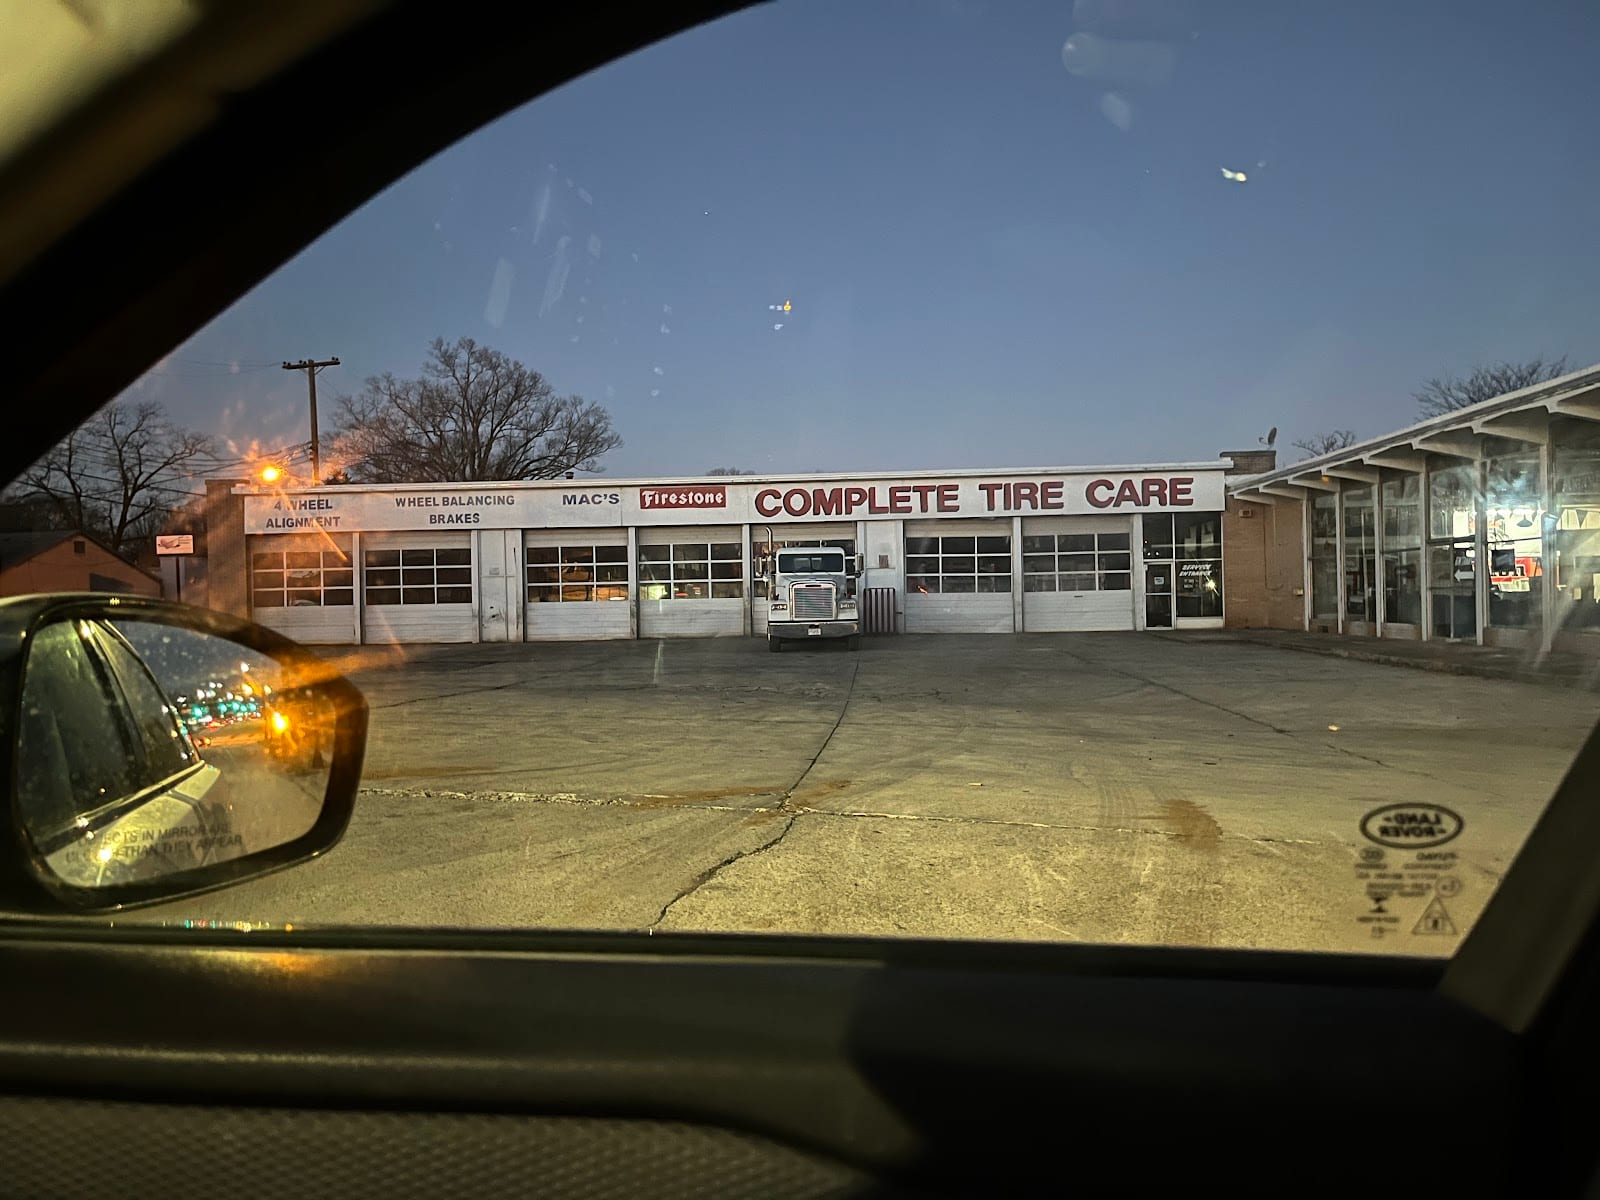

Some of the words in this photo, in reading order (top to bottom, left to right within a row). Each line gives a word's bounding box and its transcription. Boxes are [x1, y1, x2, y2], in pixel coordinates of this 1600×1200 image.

[395, 496, 440, 508] WHEEL
[442, 495, 515, 507] BALANCING
[562, 493, 620, 505] MAC'S
[641, 490, 724, 508] Firestone
[754, 484, 960, 517] COMPLETE
[978, 481, 1064, 511] TIRE
[1085, 477, 1194, 509] CARE
[274, 501, 282, 511] 4
[287, 499, 333, 510] WHEEL
[266, 516, 341, 528] ALIGNMENT
[429, 513, 480, 525] BRAKES
